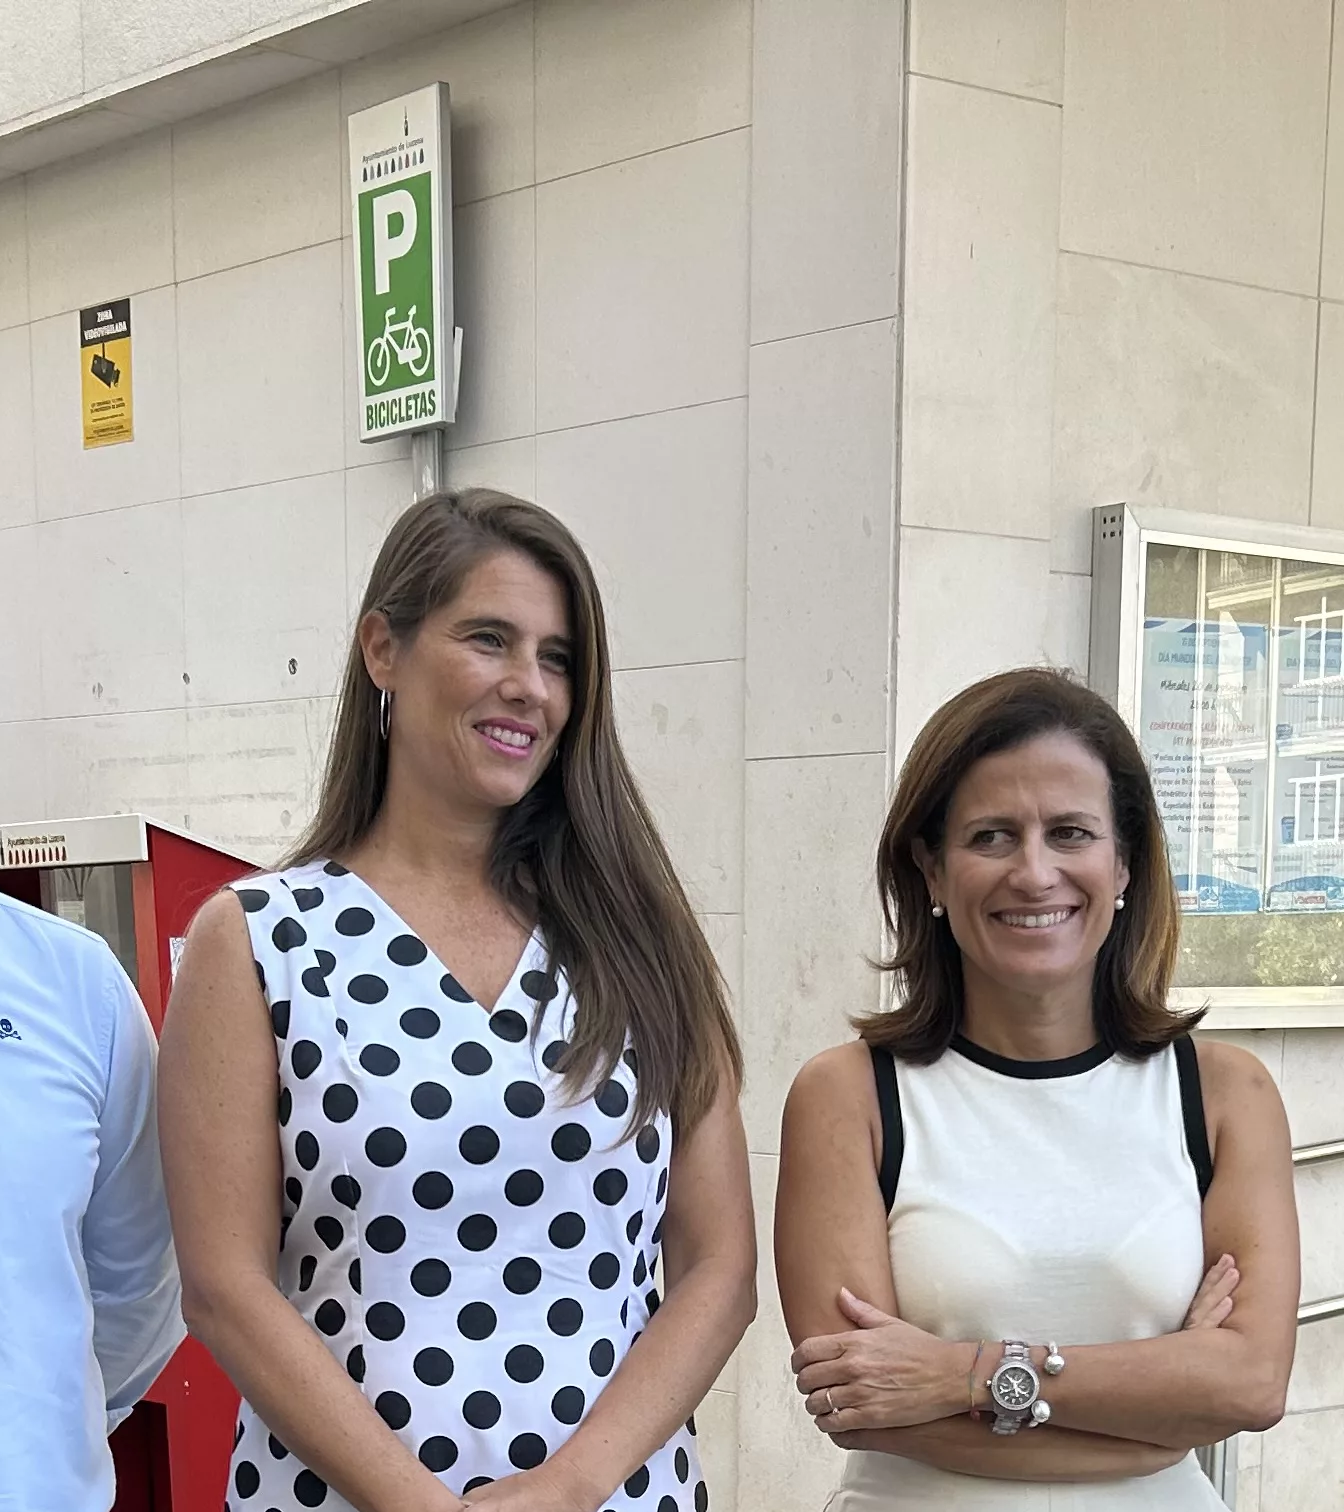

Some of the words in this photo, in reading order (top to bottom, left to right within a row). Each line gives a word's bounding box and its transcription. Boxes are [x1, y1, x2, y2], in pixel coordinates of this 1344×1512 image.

[362, 145, 398, 164] Ayuntamiento
[398, 142, 405, 151] de
[406, 137, 424, 149] Lucena
[373, 189, 418, 295] P
[366, 388, 436, 431] BICICLETAS
